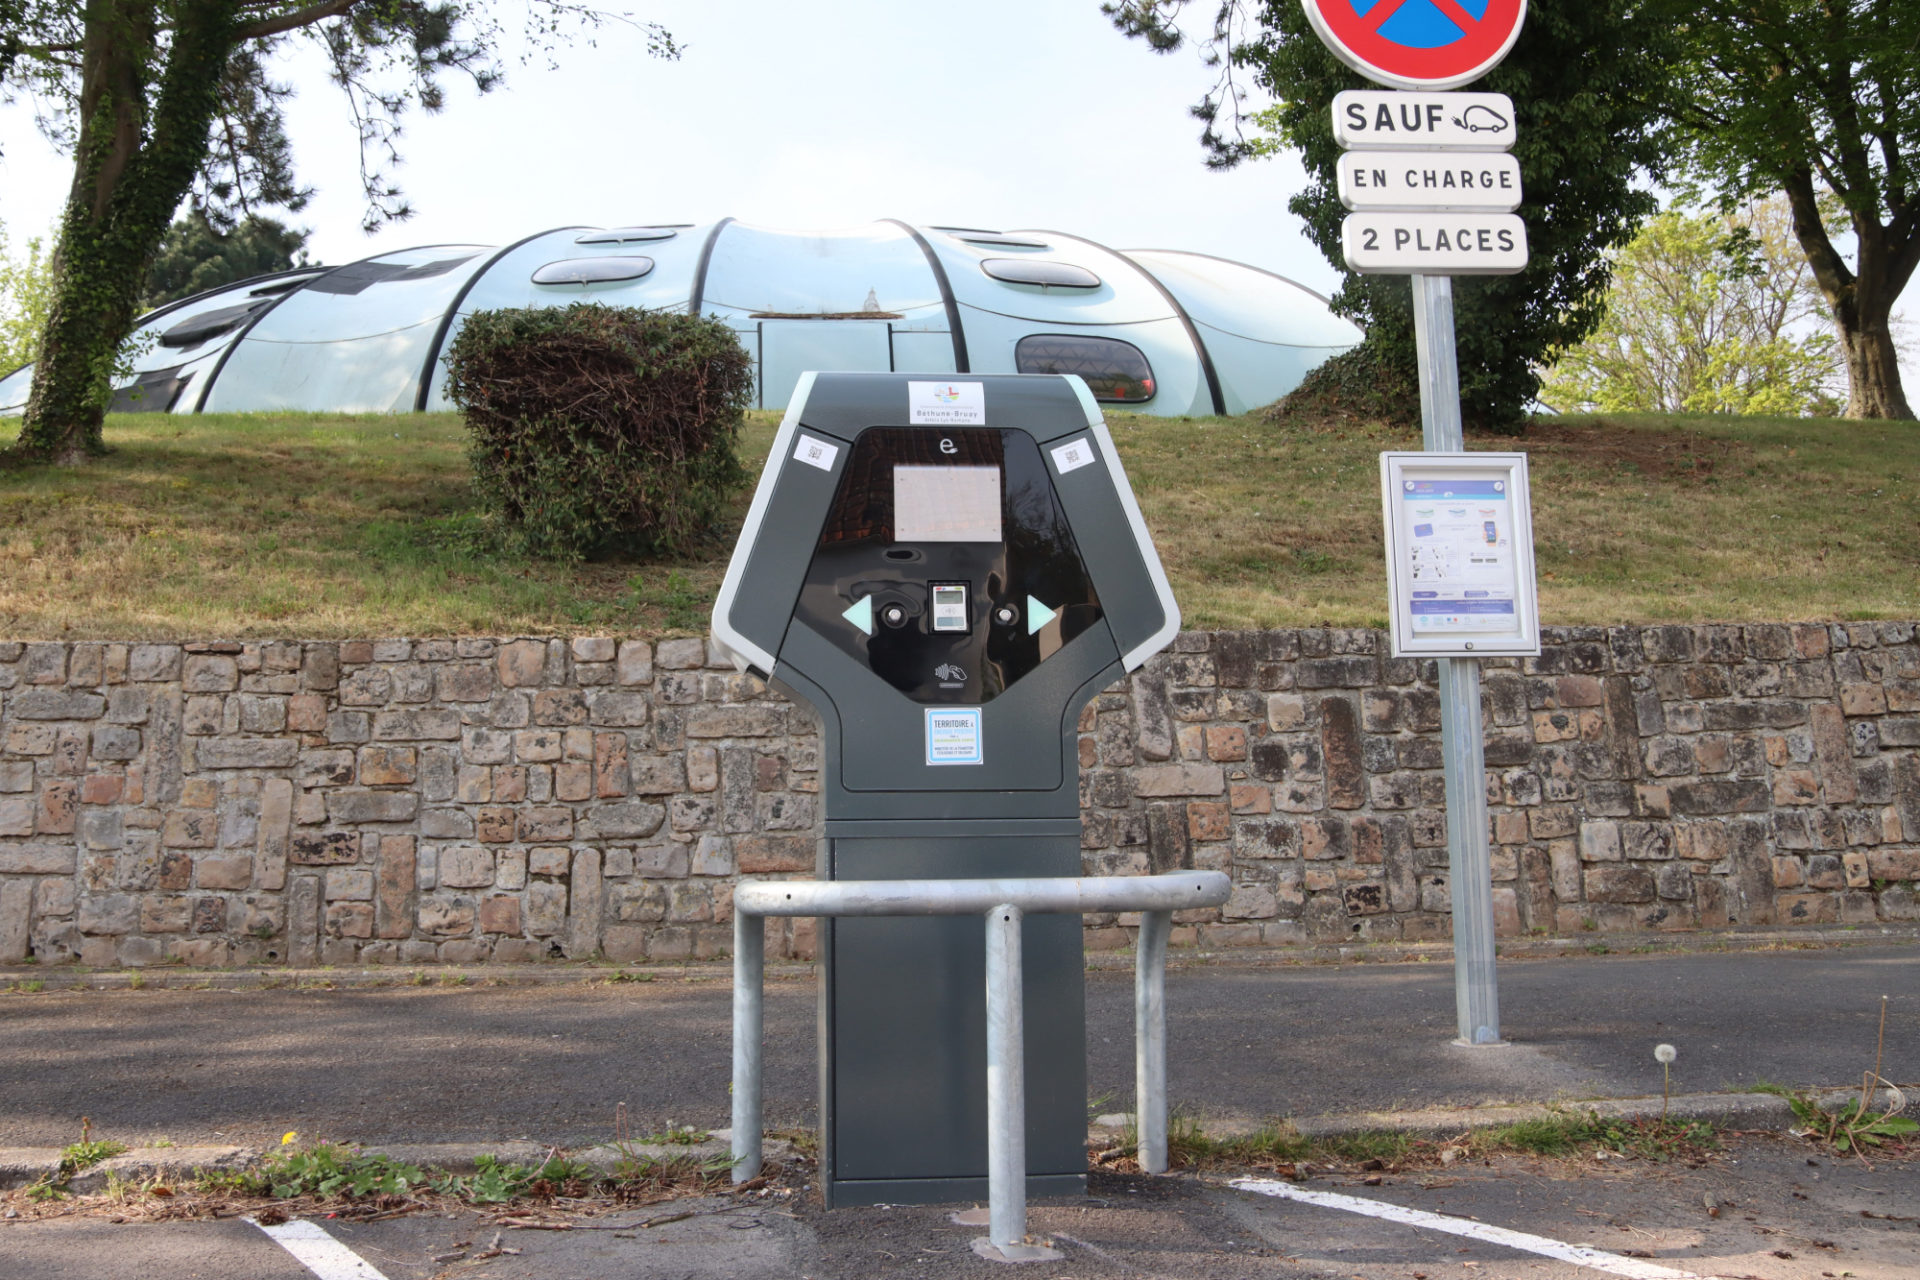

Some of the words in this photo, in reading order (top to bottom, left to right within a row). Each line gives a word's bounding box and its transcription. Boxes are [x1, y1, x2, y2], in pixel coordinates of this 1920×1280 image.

[1346, 103, 1443, 132] SAUF
[1354, 169, 1387, 188] EN
[1405, 170, 1512, 189] CHARGE
[1362, 228, 1379, 251] 2
[1394, 228, 1515, 252] PLACES
[934, 719, 969, 728] TERRITOIRE
